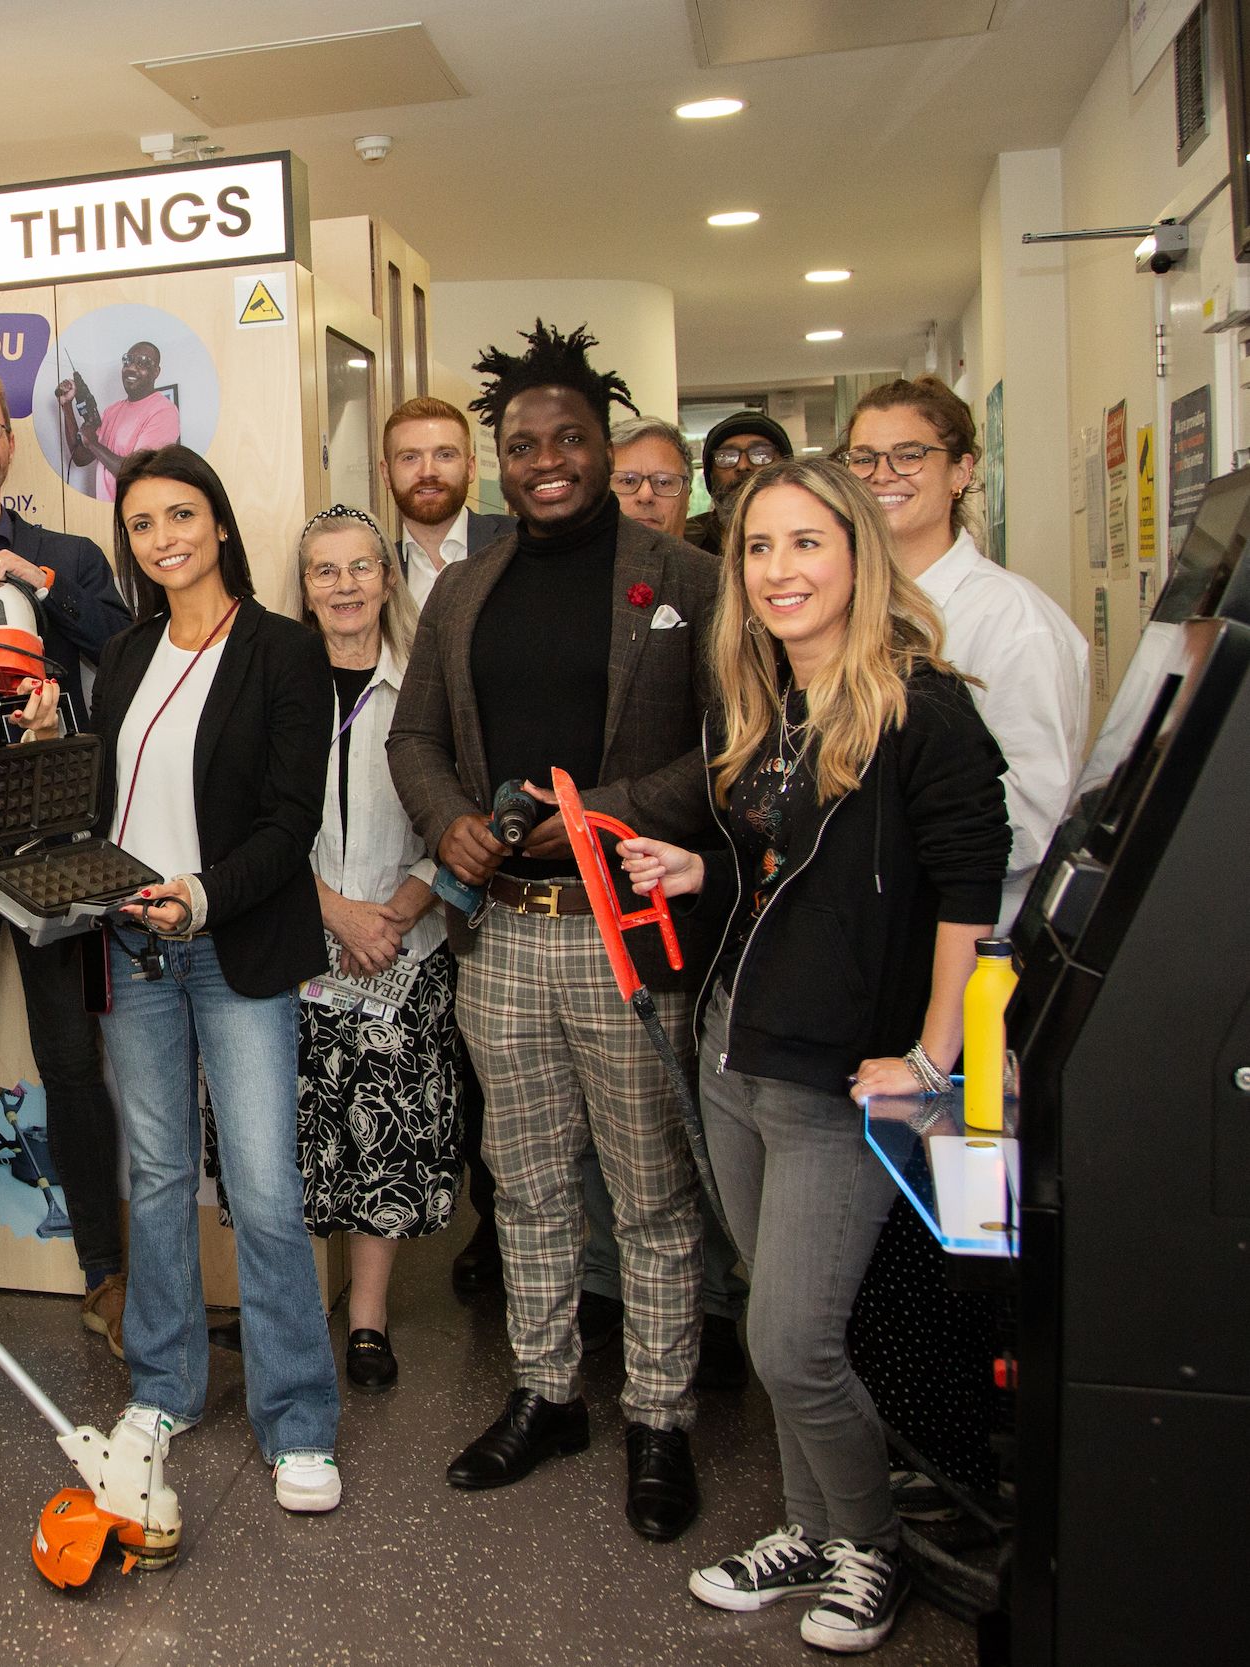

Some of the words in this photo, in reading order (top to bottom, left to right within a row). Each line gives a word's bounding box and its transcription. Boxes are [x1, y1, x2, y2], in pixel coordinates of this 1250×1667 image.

[10, 185, 252, 259] THINGS
[3, 494, 38, 514] DIY,
[350, 977, 405, 1003] FEARS
